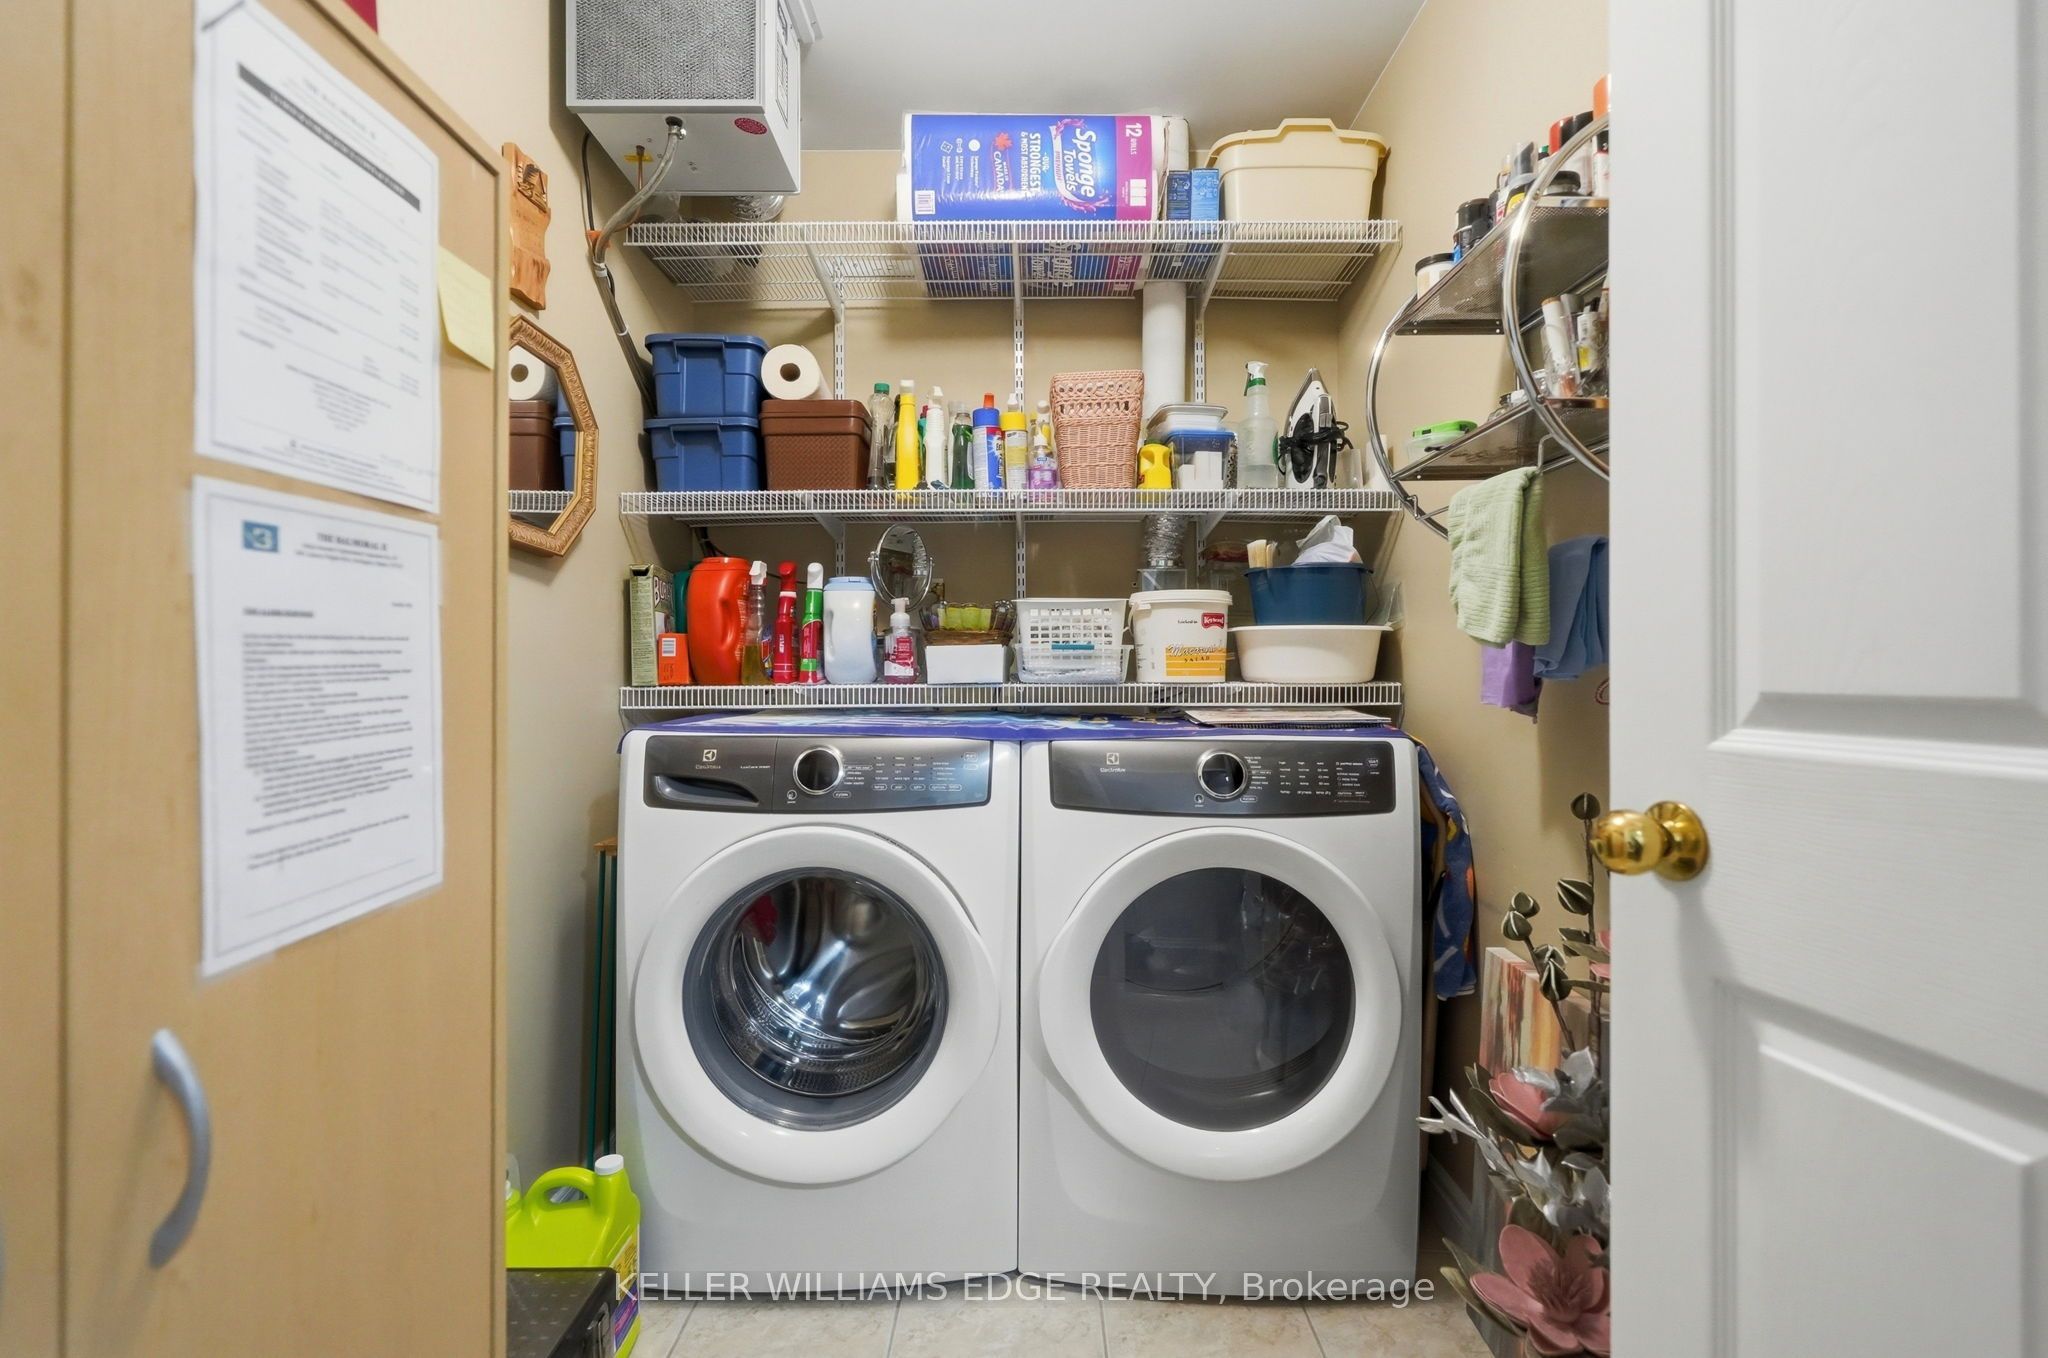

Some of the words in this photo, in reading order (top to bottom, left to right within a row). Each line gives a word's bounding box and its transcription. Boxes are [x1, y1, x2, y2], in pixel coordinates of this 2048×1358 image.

[1125, 122, 1142, 138] 12
[1020, 138, 1028, 155] MOST
[1130, 138, 1138, 155] ROLLS
[993, 151, 1005, 192] CANADA
[1029, 132, 1041, 193] STRONGEST
[1063, 149, 1078, 192] Towels
[1071, 128, 1097, 198] Sponge
[317, 532, 333, 543] THE
